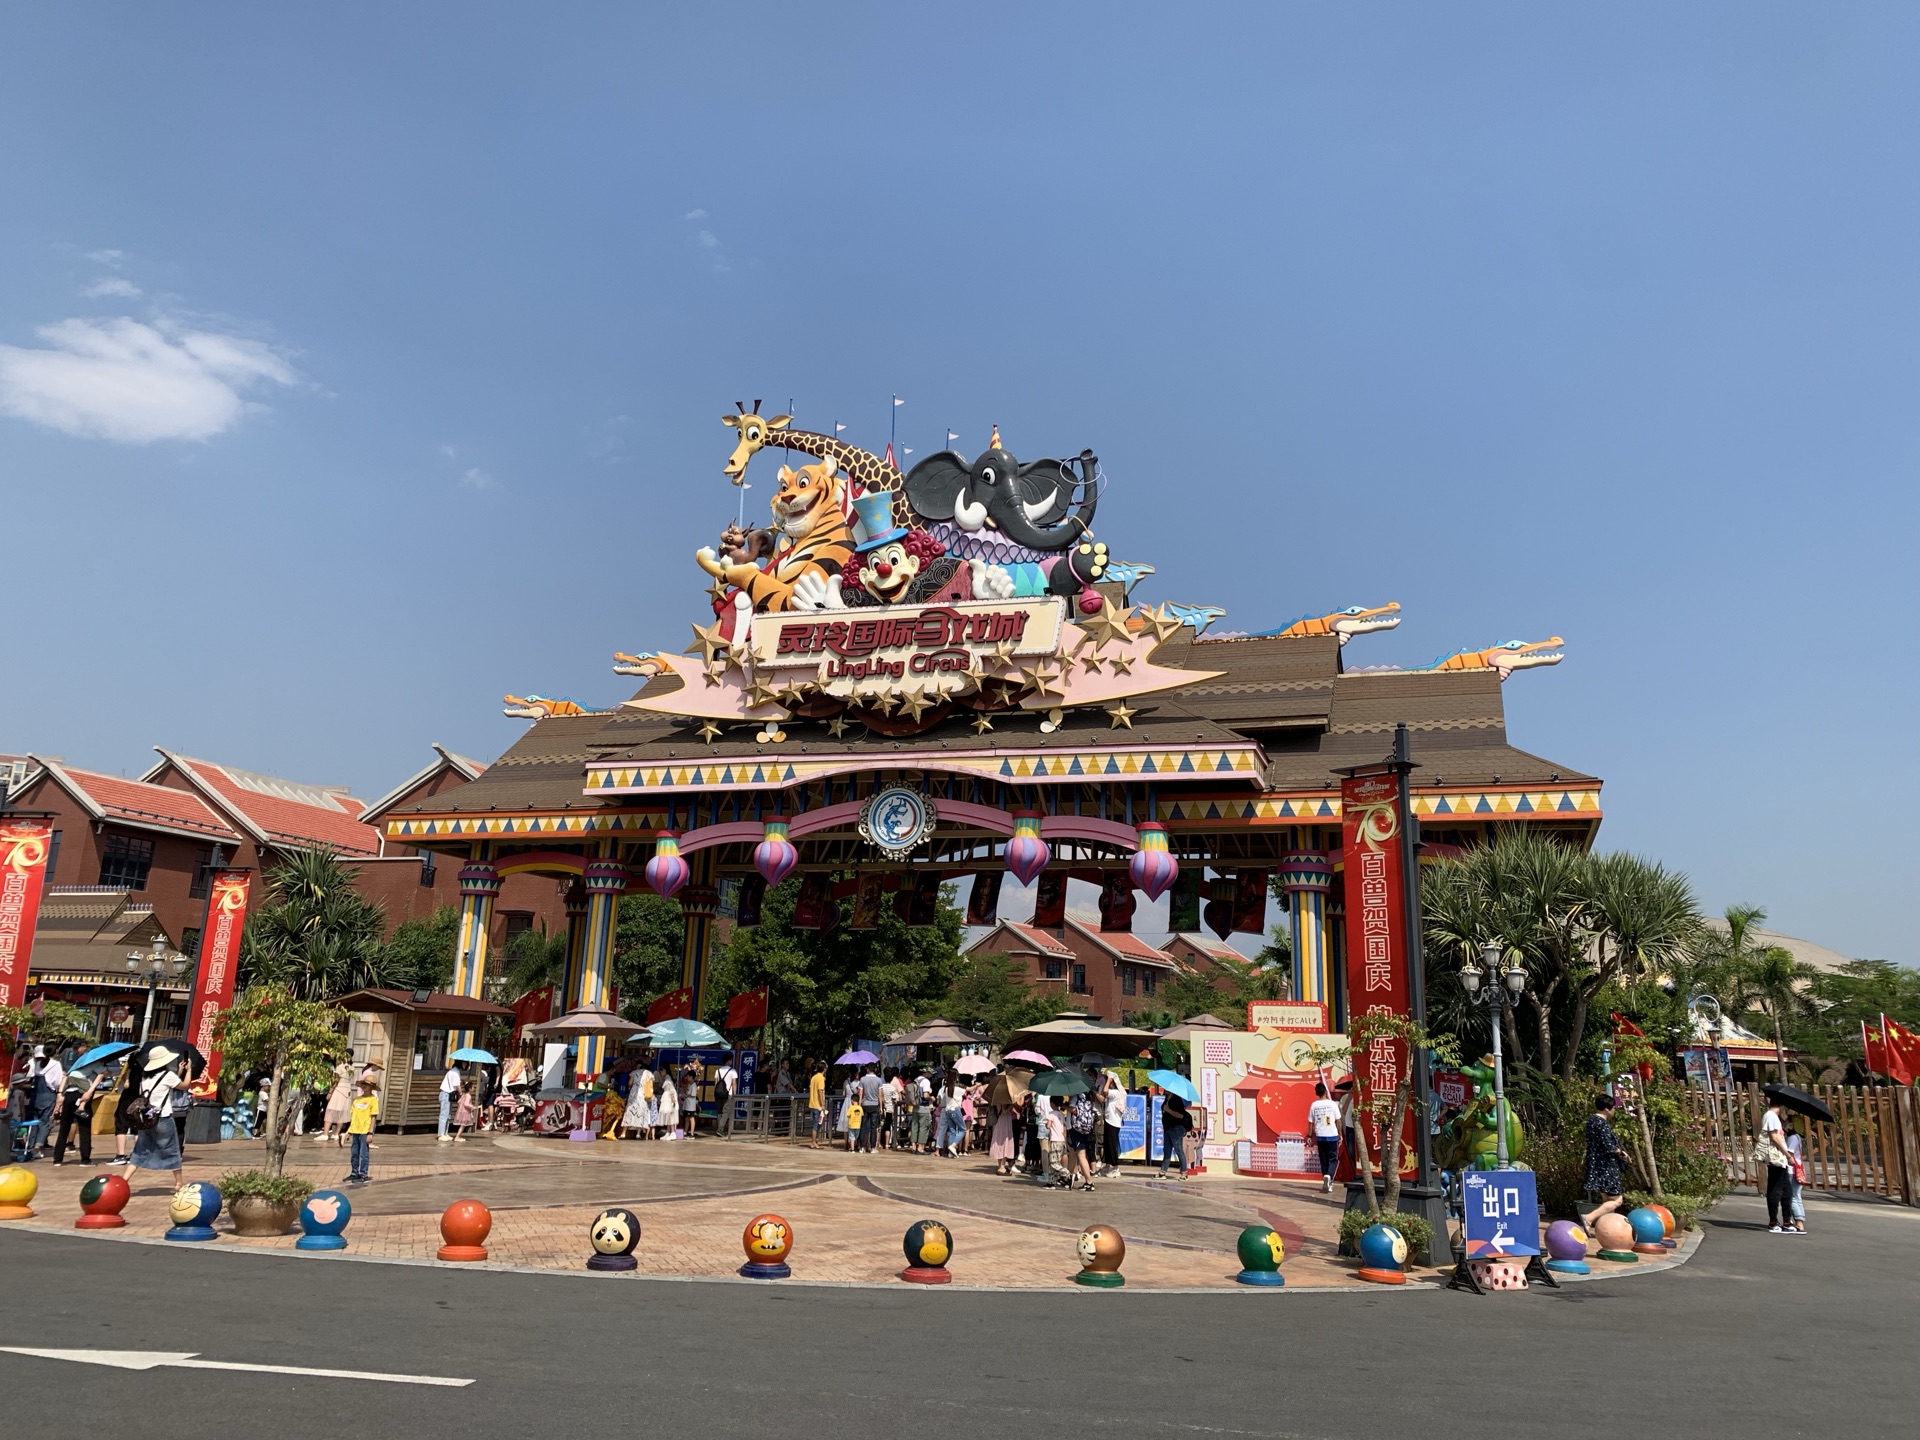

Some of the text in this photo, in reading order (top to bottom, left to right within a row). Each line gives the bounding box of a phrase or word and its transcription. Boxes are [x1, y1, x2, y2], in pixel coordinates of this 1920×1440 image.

[777, 607, 1030, 656] 灵玲国际马戏城
[827, 649, 970, 680] LingLing Circus
[1361, 852, 1392, 991] 百兽贺国庆
[1483, 1185, 1520, 1218] 出口
[1496, 1221, 1508, 1230] Exit
